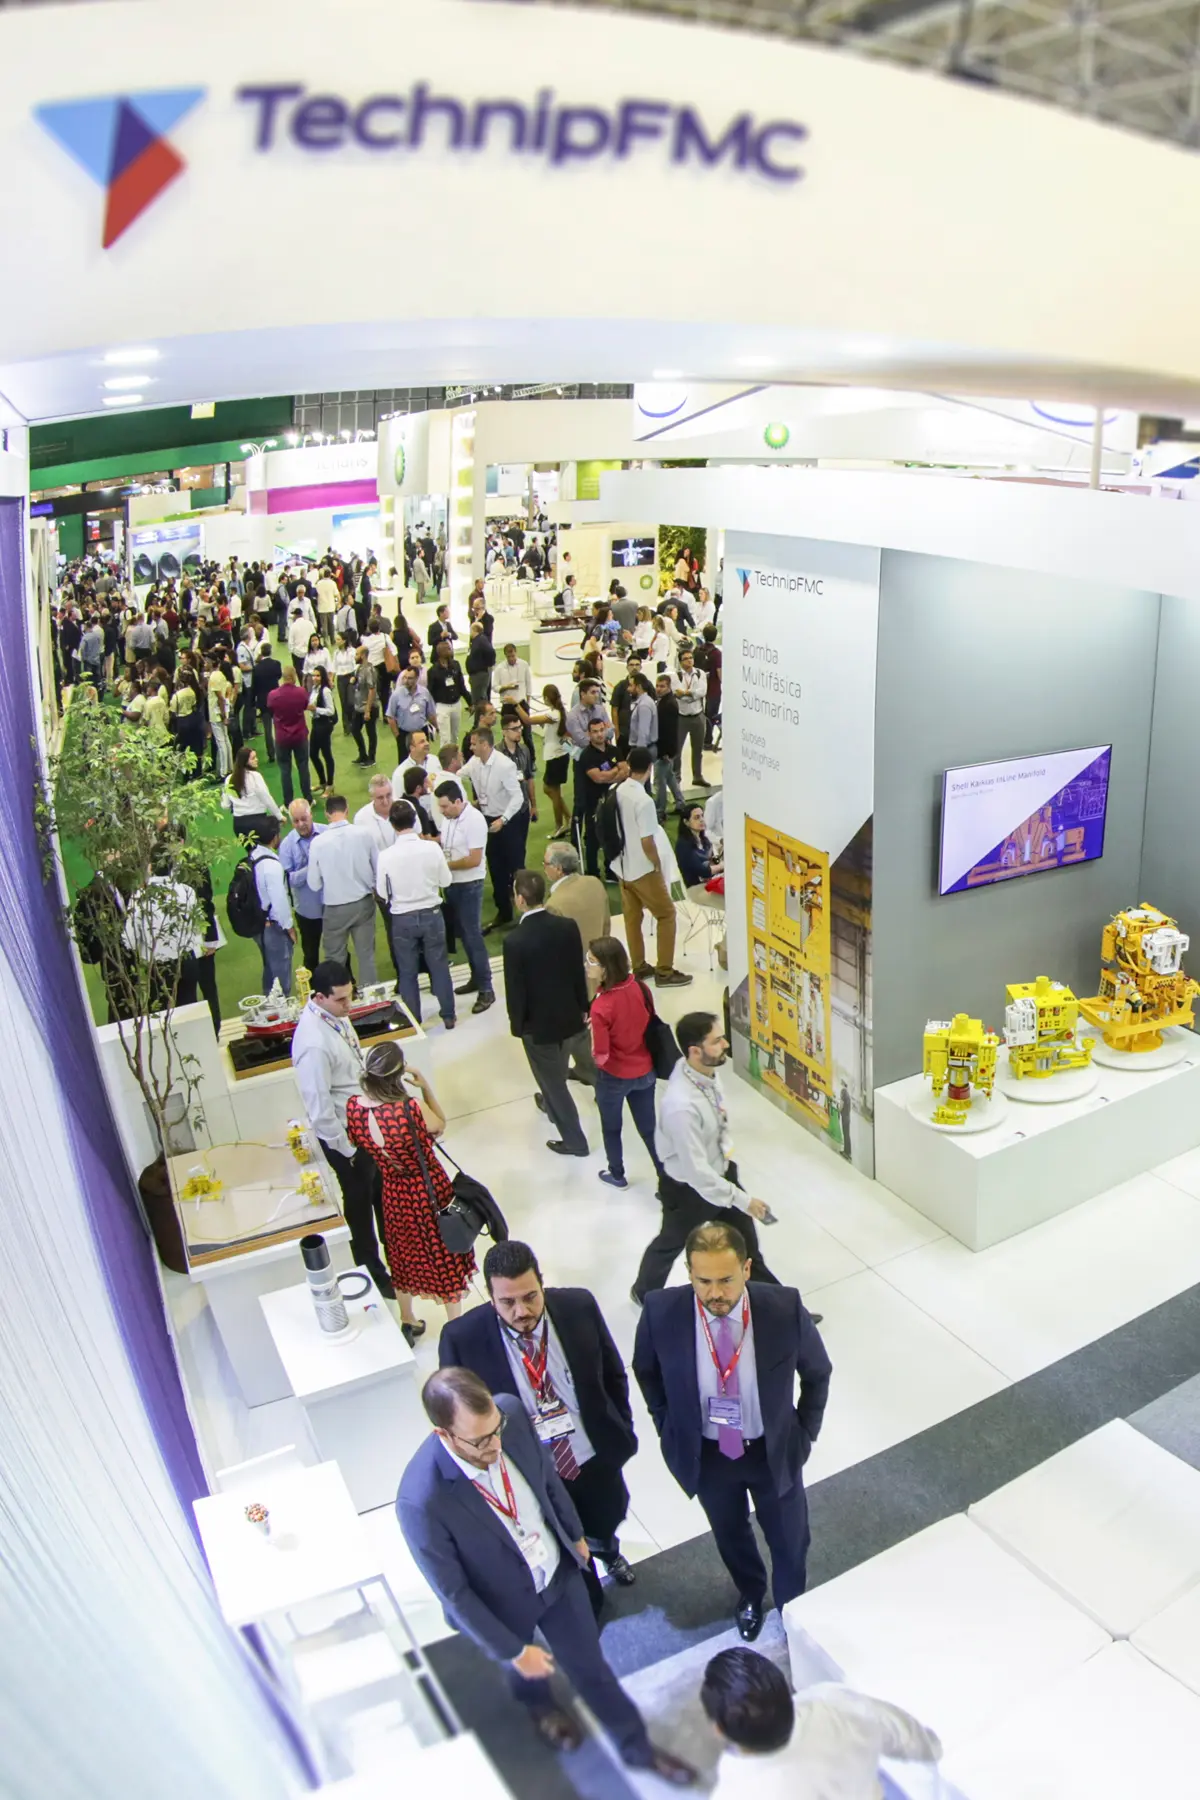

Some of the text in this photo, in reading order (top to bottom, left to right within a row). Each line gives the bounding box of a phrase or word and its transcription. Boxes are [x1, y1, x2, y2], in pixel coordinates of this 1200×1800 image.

[236, 80, 811, 183] TechnipFMC
[754, 570, 824, 596] TechnipFMC
[742, 638, 779, 665] Bomba
[742, 665, 802, 699] Multifásica
[741, 690, 800, 726] Submarina
[741, 728, 767, 748] Subsea
[741, 746, 781, 772] Multiphase
[741, 762, 762, 781] Pump
[951, 782, 969, 792] Shell
[1018, 769, 1046, 779] Manifold
